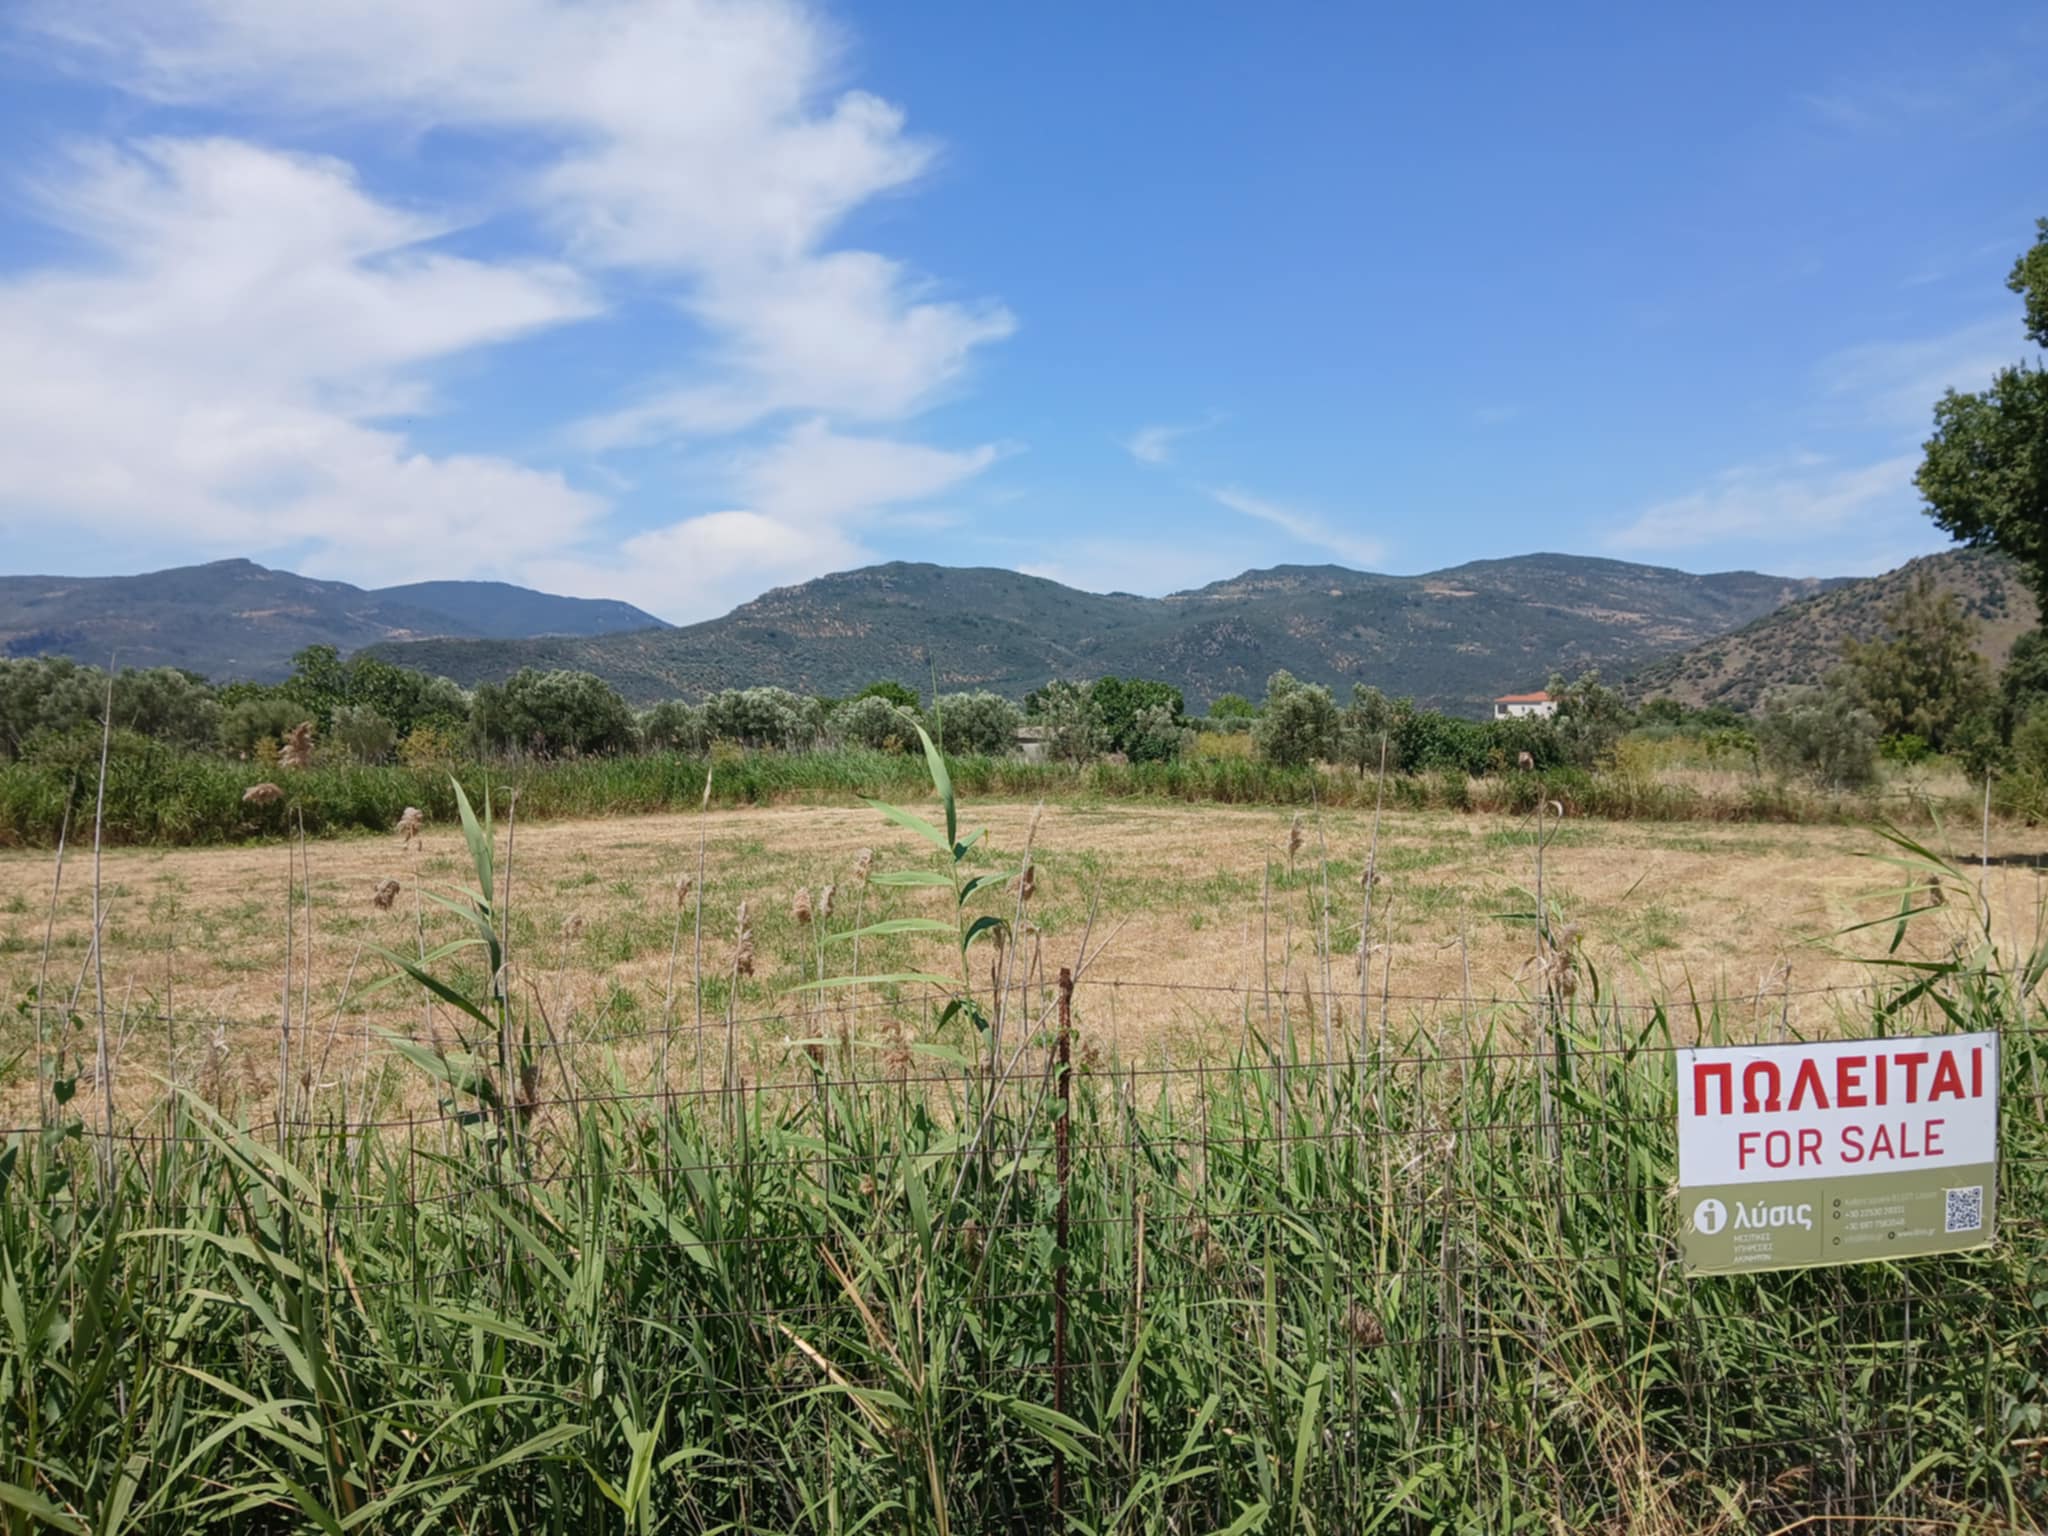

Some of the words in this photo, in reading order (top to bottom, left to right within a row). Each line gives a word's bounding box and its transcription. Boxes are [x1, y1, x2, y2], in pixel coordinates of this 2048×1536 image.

[1693, 1047, 1983, 1116] ΠΩΛΕΙΤΑΙ
[1738, 1128, 1823, 1170] FOR
[1840, 1118, 1945, 1163] SALE
[1733, 1200, 1813, 1231] λύσις
